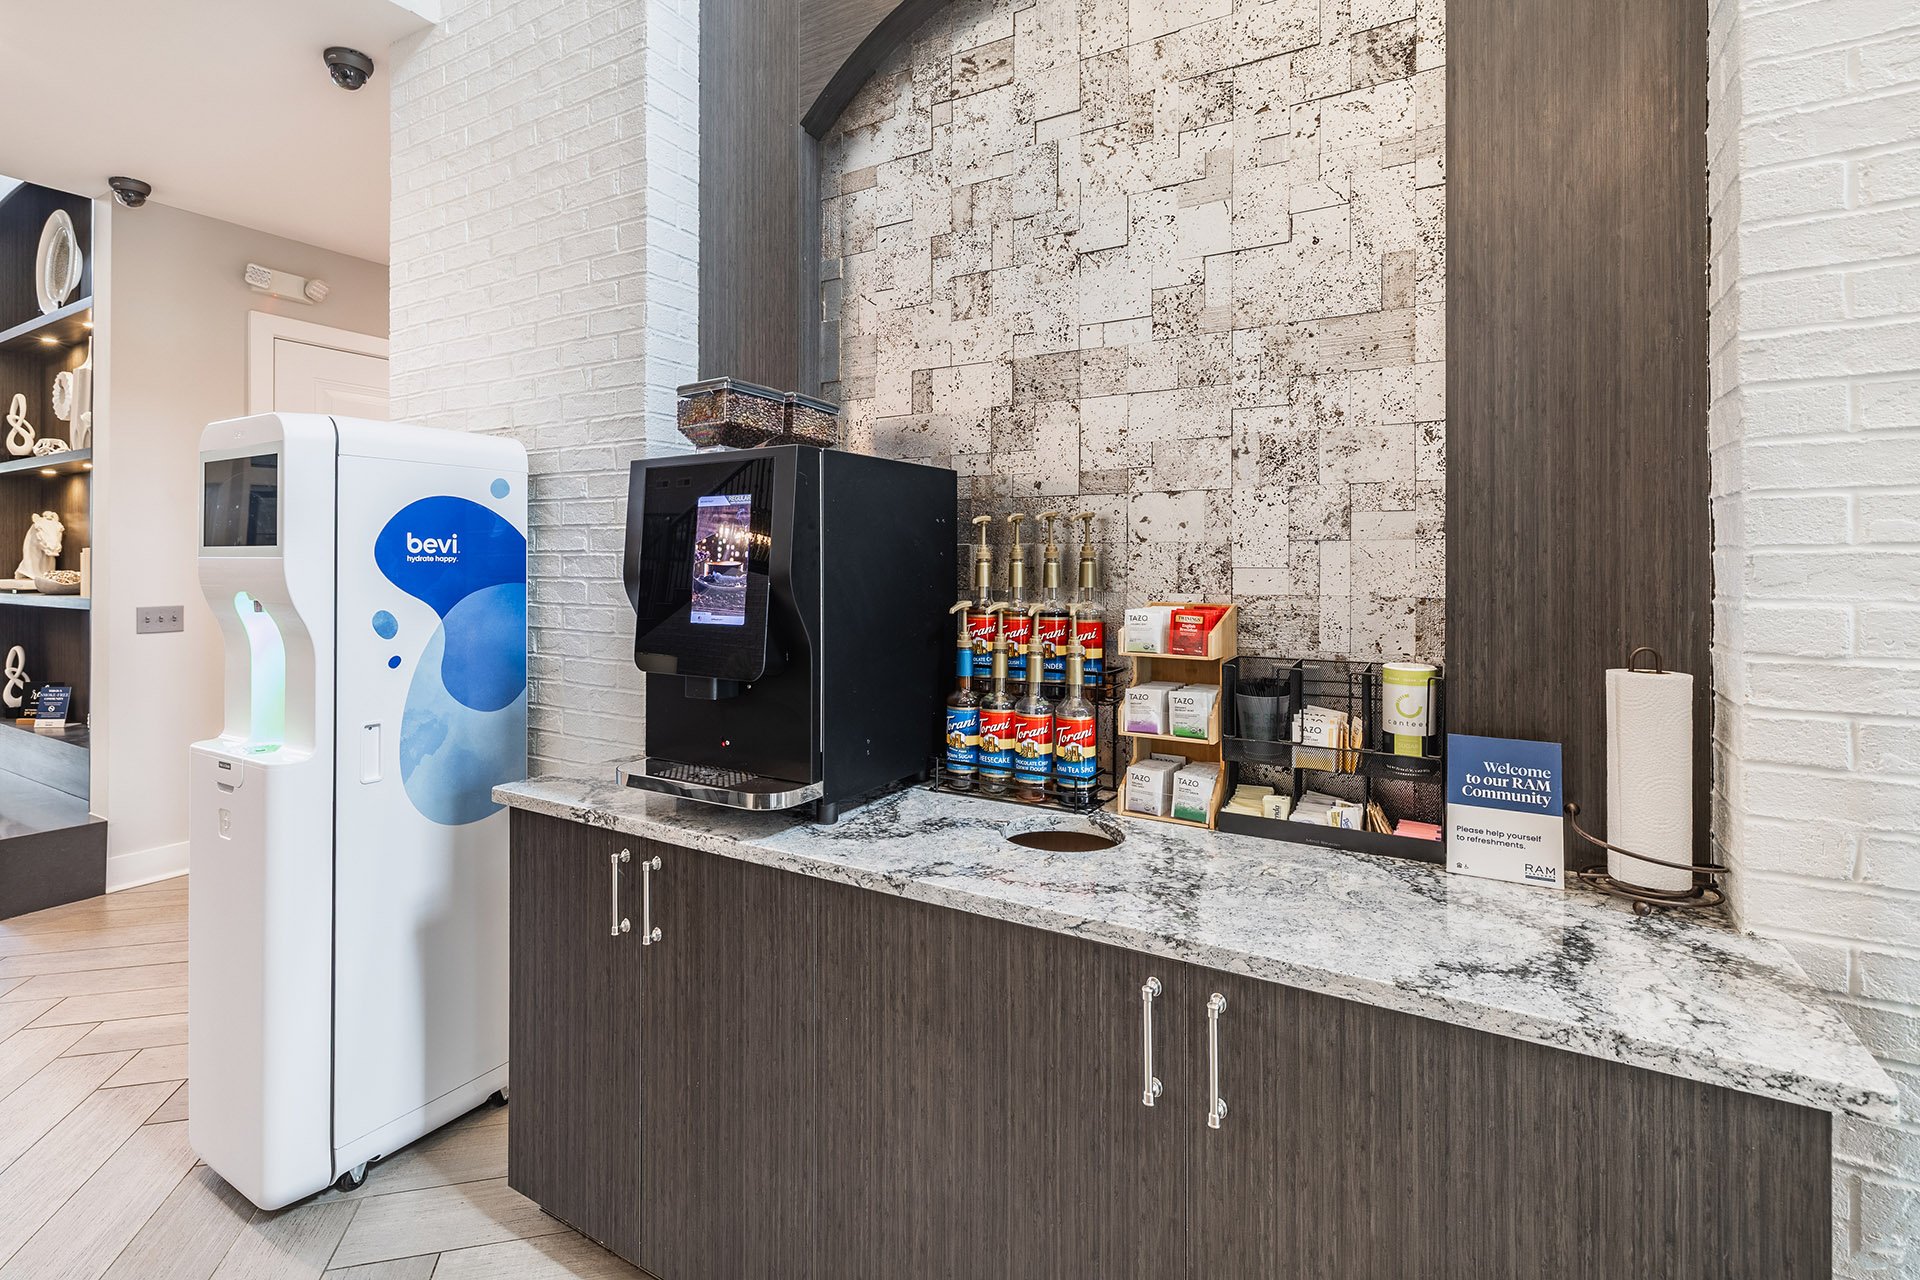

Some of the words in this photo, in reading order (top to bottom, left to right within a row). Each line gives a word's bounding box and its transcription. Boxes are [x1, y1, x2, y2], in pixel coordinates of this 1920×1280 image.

[406, 555, 434, 563] hydrate
[1173, 697, 1194, 705] TAZO
[980, 718, 1011, 735] Torani
[1388, 719, 1424, 728] cantee
[1014, 722, 1049, 742] Torani
[1056, 725, 1093, 748] Torani
[1131, 773, 1151, 782] TAZO
[1484, 761, 1551, 779] Welcome
[1178, 778, 1199, 787] TAZO
[1466, 773, 1480, 785] to
[1483, 776, 1509, 787] our
[1512, 777, 1551, 792] RAM
[1462, 785, 1551, 808] Community
[1456, 825, 1484, 835] Please
[1486, 828, 1504, 839] help
[1507, 832, 1542, 843] yourself
[1467, 836, 1526, 850] refreshments.
[1524, 863, 1556, 876] RAM
